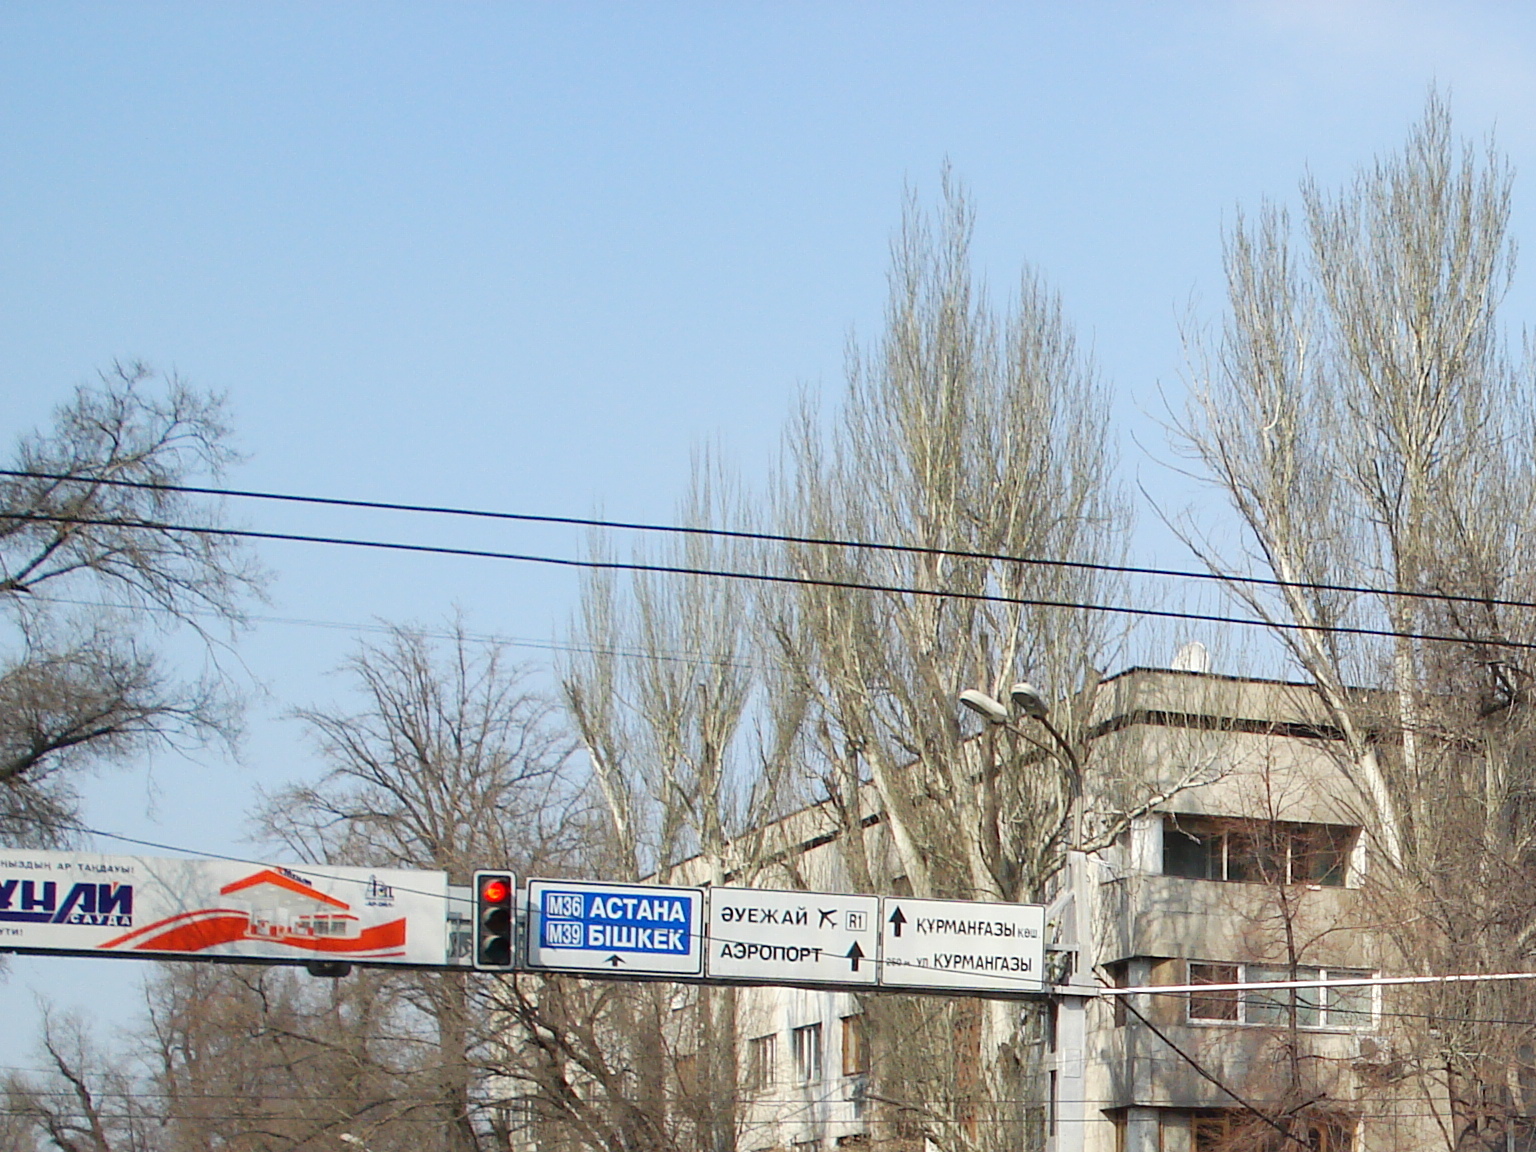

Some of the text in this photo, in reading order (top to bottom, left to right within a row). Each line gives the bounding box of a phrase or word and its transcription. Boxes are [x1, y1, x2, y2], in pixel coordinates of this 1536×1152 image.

[589, 897, 686, 922] АСТАНА
[721, 906, 808, 925] ӘУЕЖАЙ
[70, 914, 132, 927] САУДА
[849, 913, 862, 929] R1
[916, 918, 1016, 939] ҚҰРМАНҒАЗЫ
[588, 925, 685, 950] БІШКЕК
[720, 943, 823, 962] АЭРОПОРТ
[934, 953, 1032, 972] КУРМАНГАЗЫ
